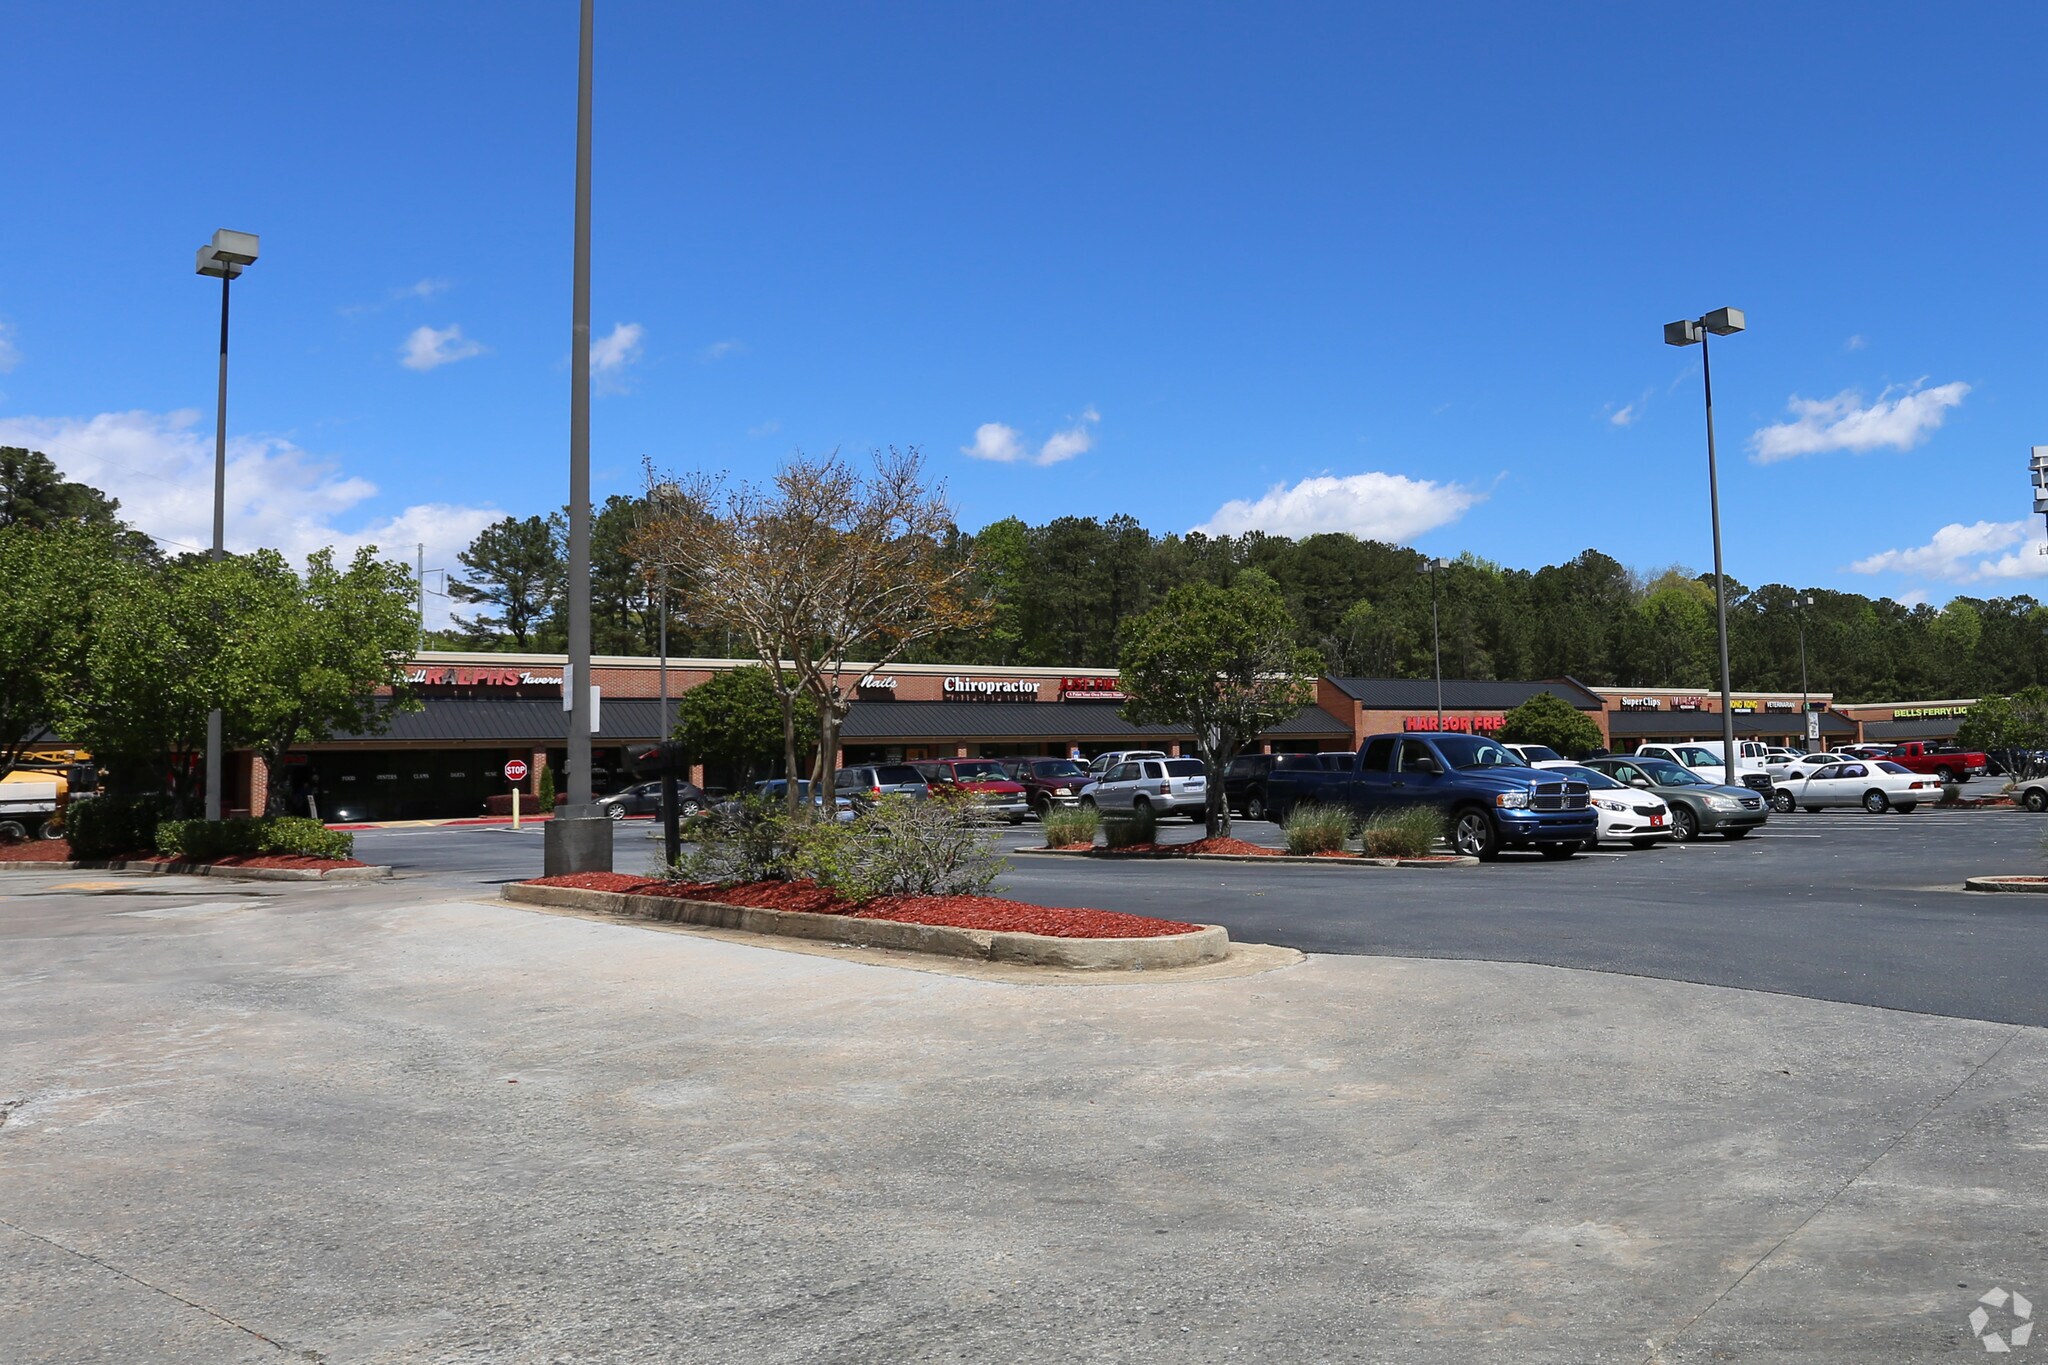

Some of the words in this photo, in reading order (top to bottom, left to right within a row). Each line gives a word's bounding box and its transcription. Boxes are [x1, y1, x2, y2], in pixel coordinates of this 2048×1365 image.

[392, 669, 426, 683] rill
[425, 668, 520, 685] RALPHS
[519, 672, 563, 685] Tavern
[860, 675, 898, 688] Nails
[943, 677, 1040, 694] Chiropractor
[1058, 677, 1091, 690] JUST
[1095, 677, 1120, 690] FIR
[1743, 700, 1758, 709] KONG
[1894, 708, 1922, 717] BELLS
[1923, 707, 1952, 716] FERRY
[1406, 716, 1470, 731] HARBOR
[1473, 716, 1507, 731] FRE
[506, 765, 526, 775] STOP
